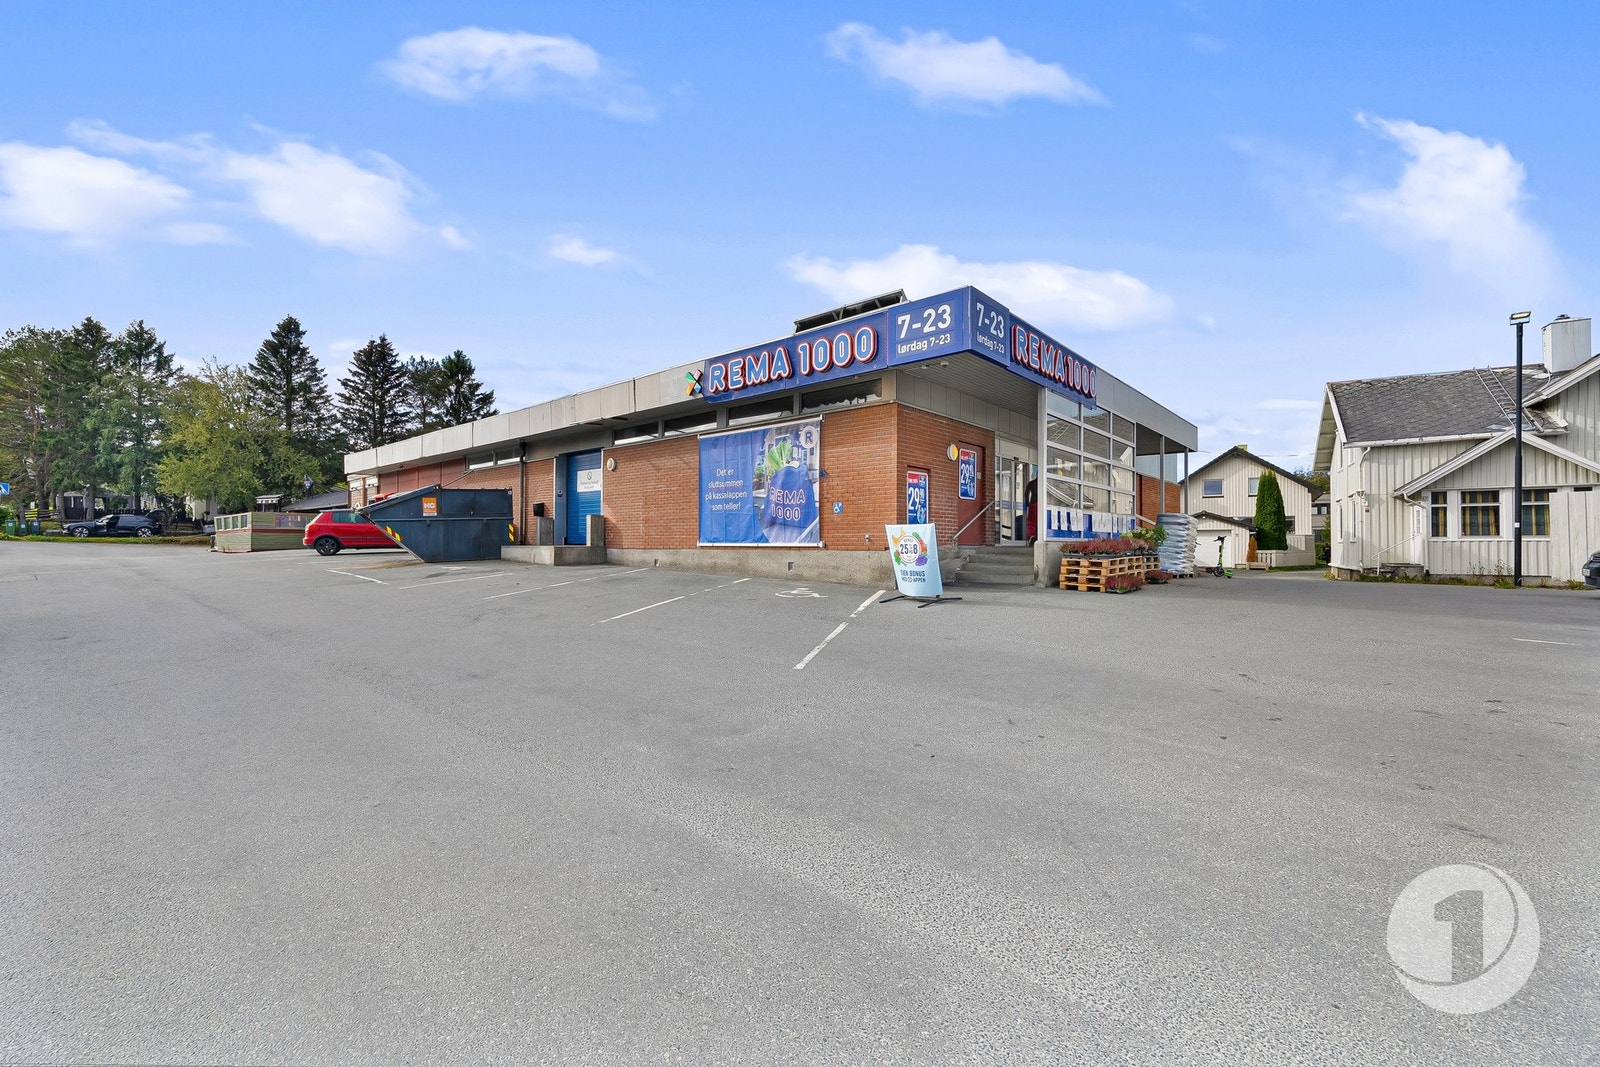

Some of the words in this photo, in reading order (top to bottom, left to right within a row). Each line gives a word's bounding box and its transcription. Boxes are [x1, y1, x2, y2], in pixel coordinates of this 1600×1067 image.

[897, 304, 951, 339] 7-23
[976, 301, 1005, 339] 7-23
[897, 338, 928, 354] lørdag
[929, 333, 951, 347] 7-23
[976, 331, 993, 351] lørdag
[993, 339, 1005, 354] 7-23
[708, 344, 793, 395] REMA
[798, 324, 878, 377] 1000
[1011, 324, 1065, 383] REMA
[1065, 355, 1096, 398] 1000
[716, 468, 727, 477] Det
[770, 486, 805, 504] REMA
[908, 487, 920, 511] 29
[772, 504, 801, 522] 1000
[900, 544, 908, 554] 25
[913, 544, 918, 554] 8
